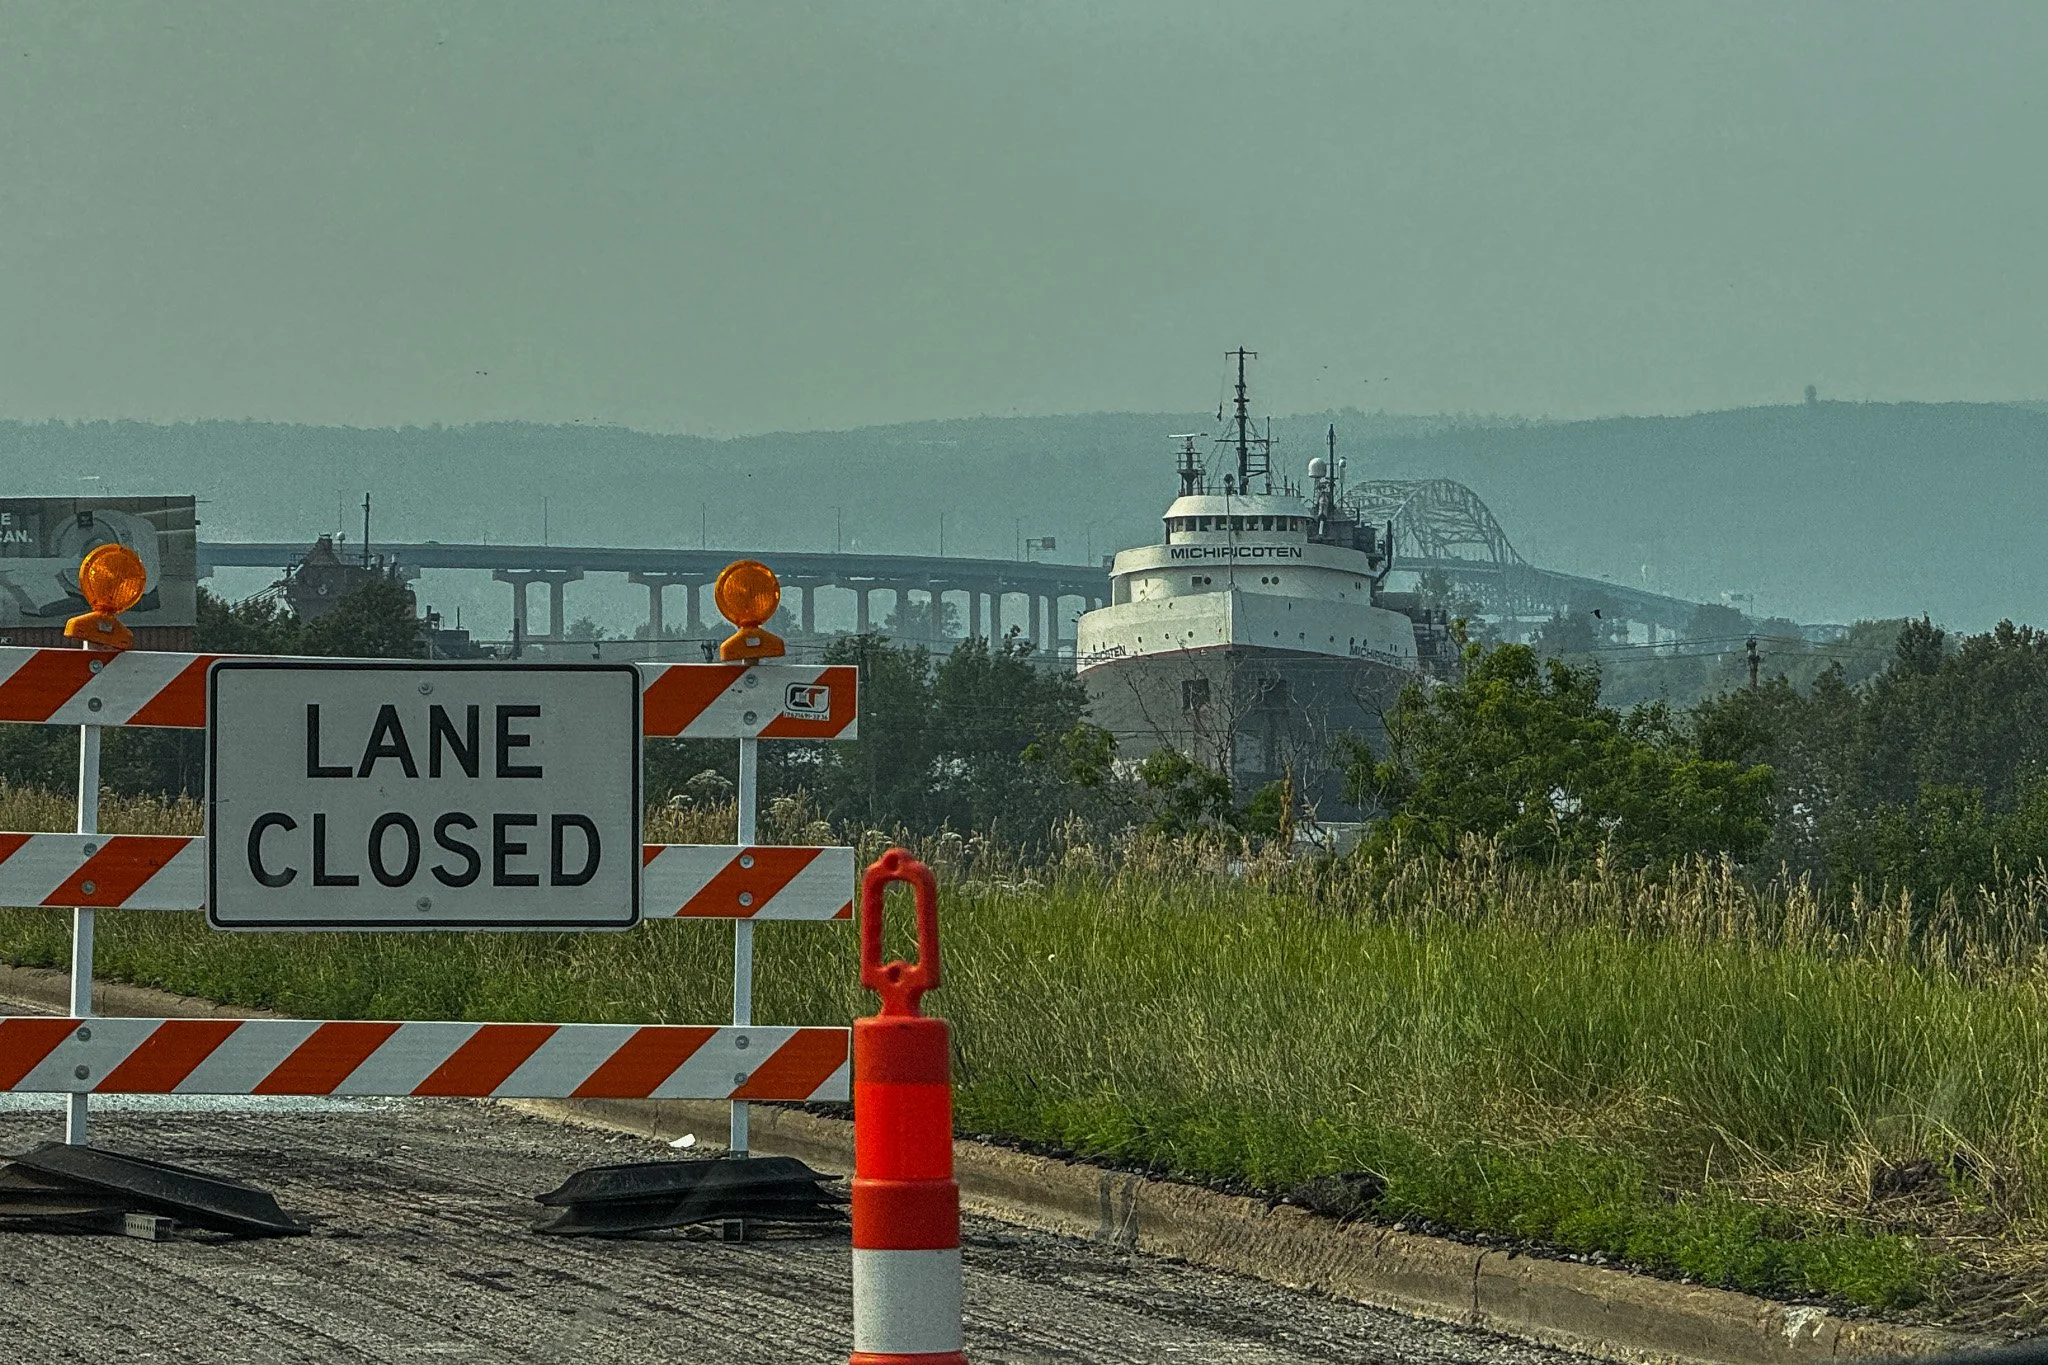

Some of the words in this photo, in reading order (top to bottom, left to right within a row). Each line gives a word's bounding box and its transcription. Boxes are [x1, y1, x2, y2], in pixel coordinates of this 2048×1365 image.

[0, 529, 33, 543] AN.
[1170, 546, 1302, 559] MICHIPICOTEN
[306, 703, 543, 779] LANE
[247, 811, 601, 889] CLOSED
